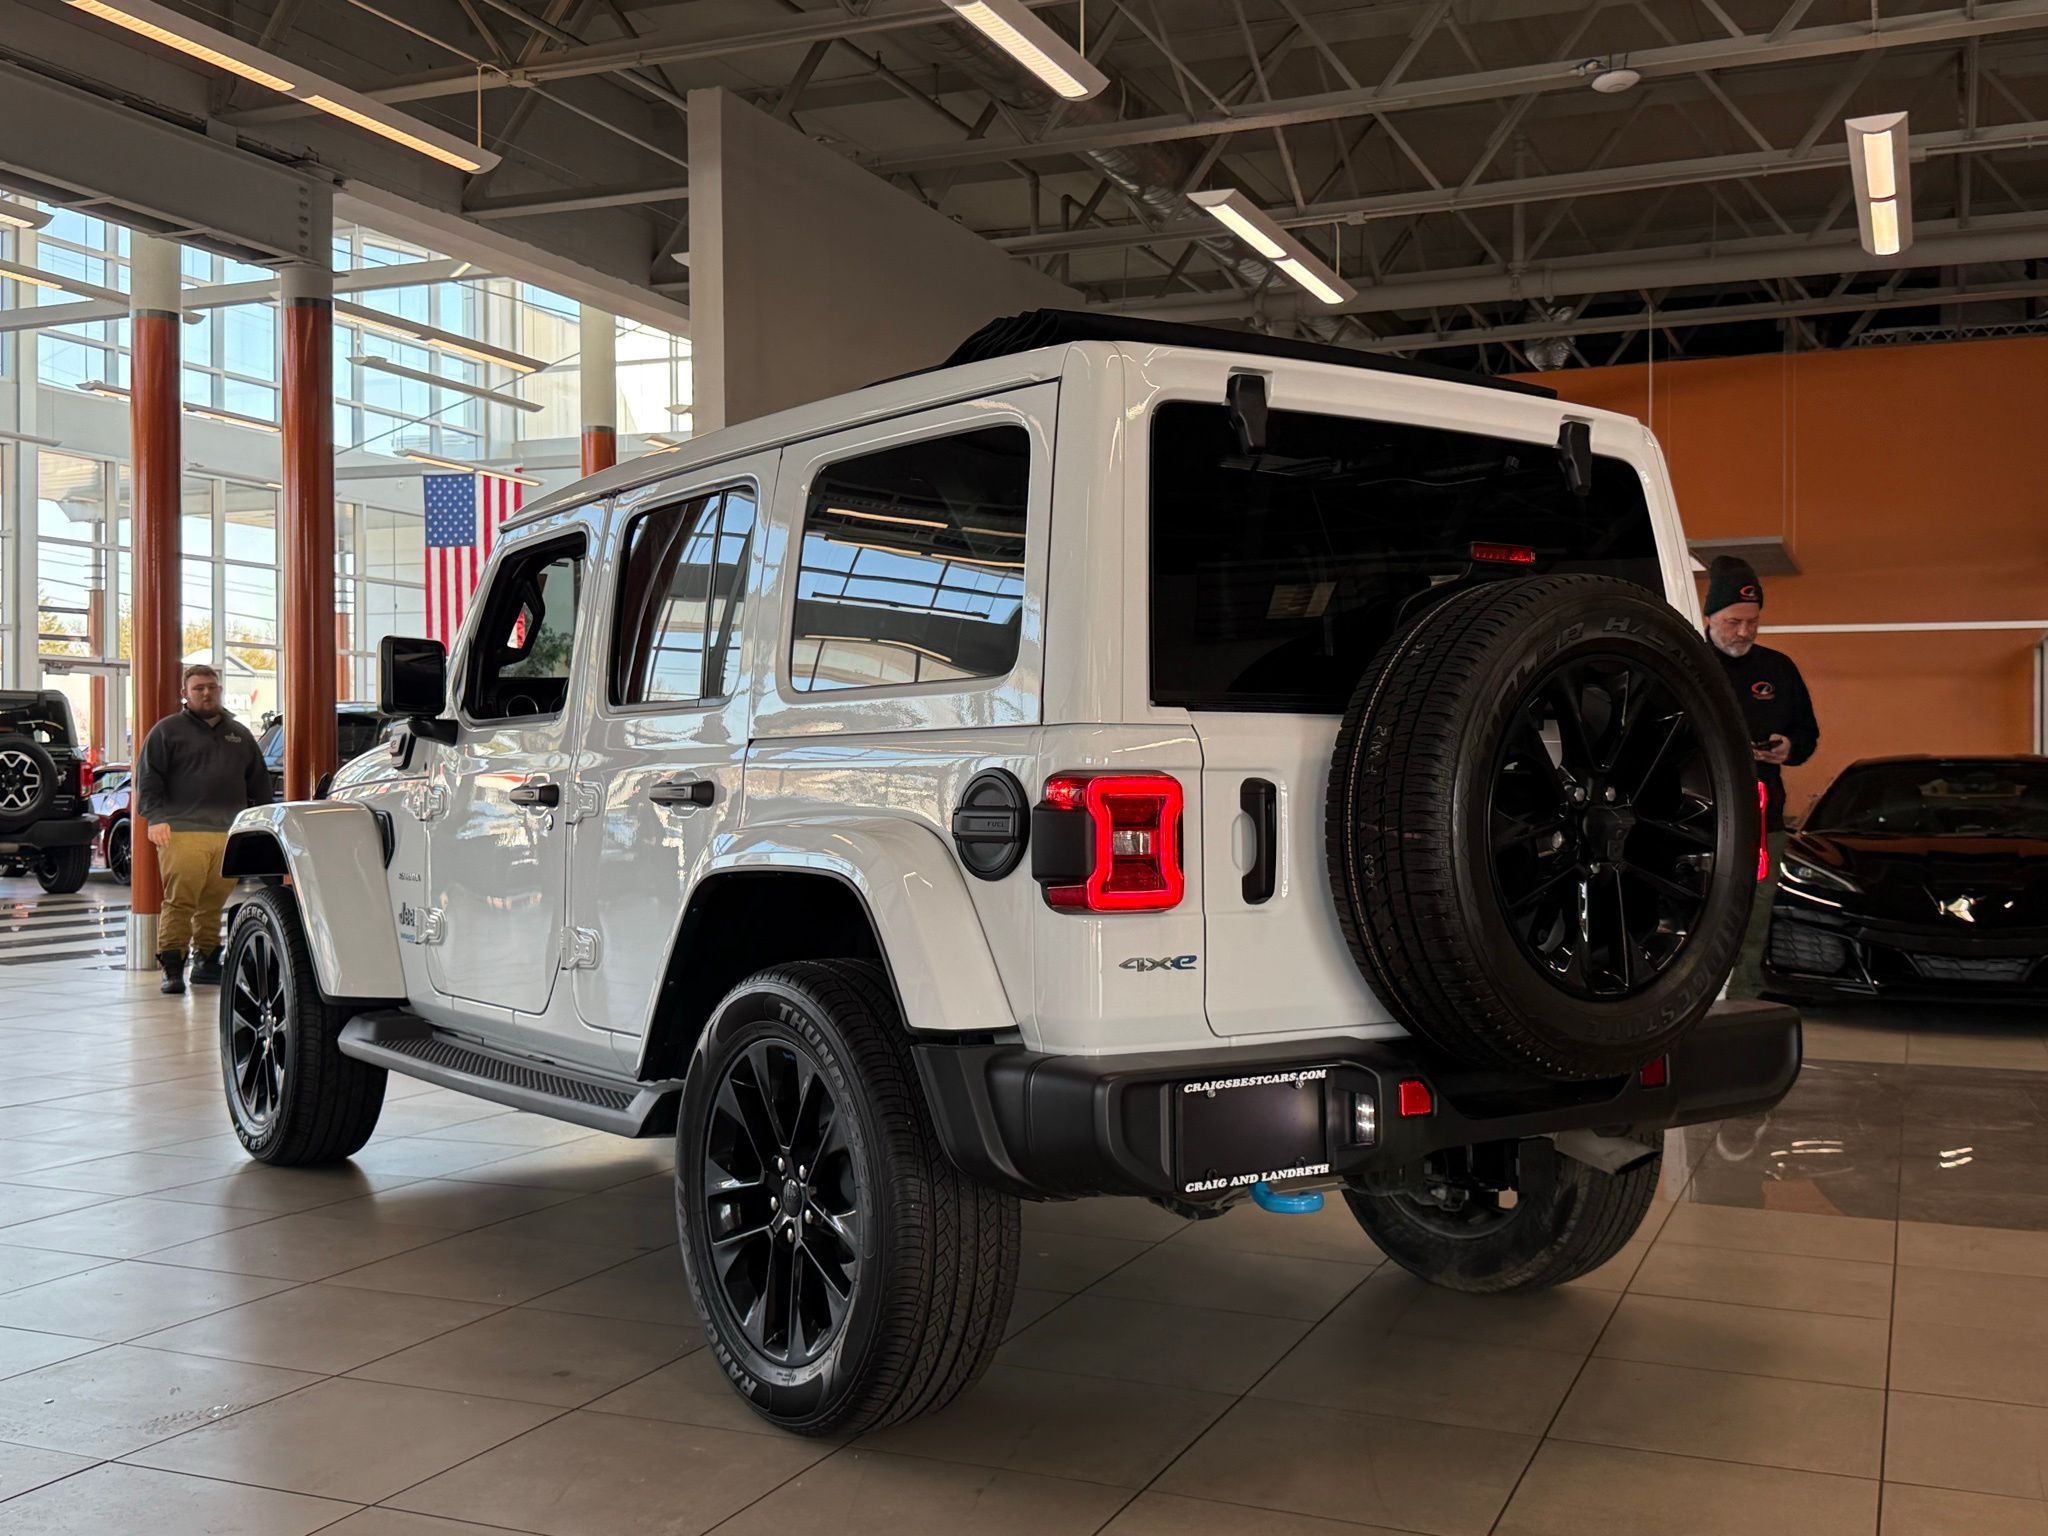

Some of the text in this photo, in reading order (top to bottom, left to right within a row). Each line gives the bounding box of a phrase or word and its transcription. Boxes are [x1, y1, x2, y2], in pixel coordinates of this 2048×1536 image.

[987, 821, 1005, 829] FUEL
[399, 902, 416, 927] Jee
[1183, 1069, 1327, 1093] CRAIGSBESTCARS.COM
[779, 1002, 873, 1217] THUNDERER
[1185, 1163, 1329, 1193] CRAIG AND LANDRETH
[686, 1276, 757, 1397] RANGER
